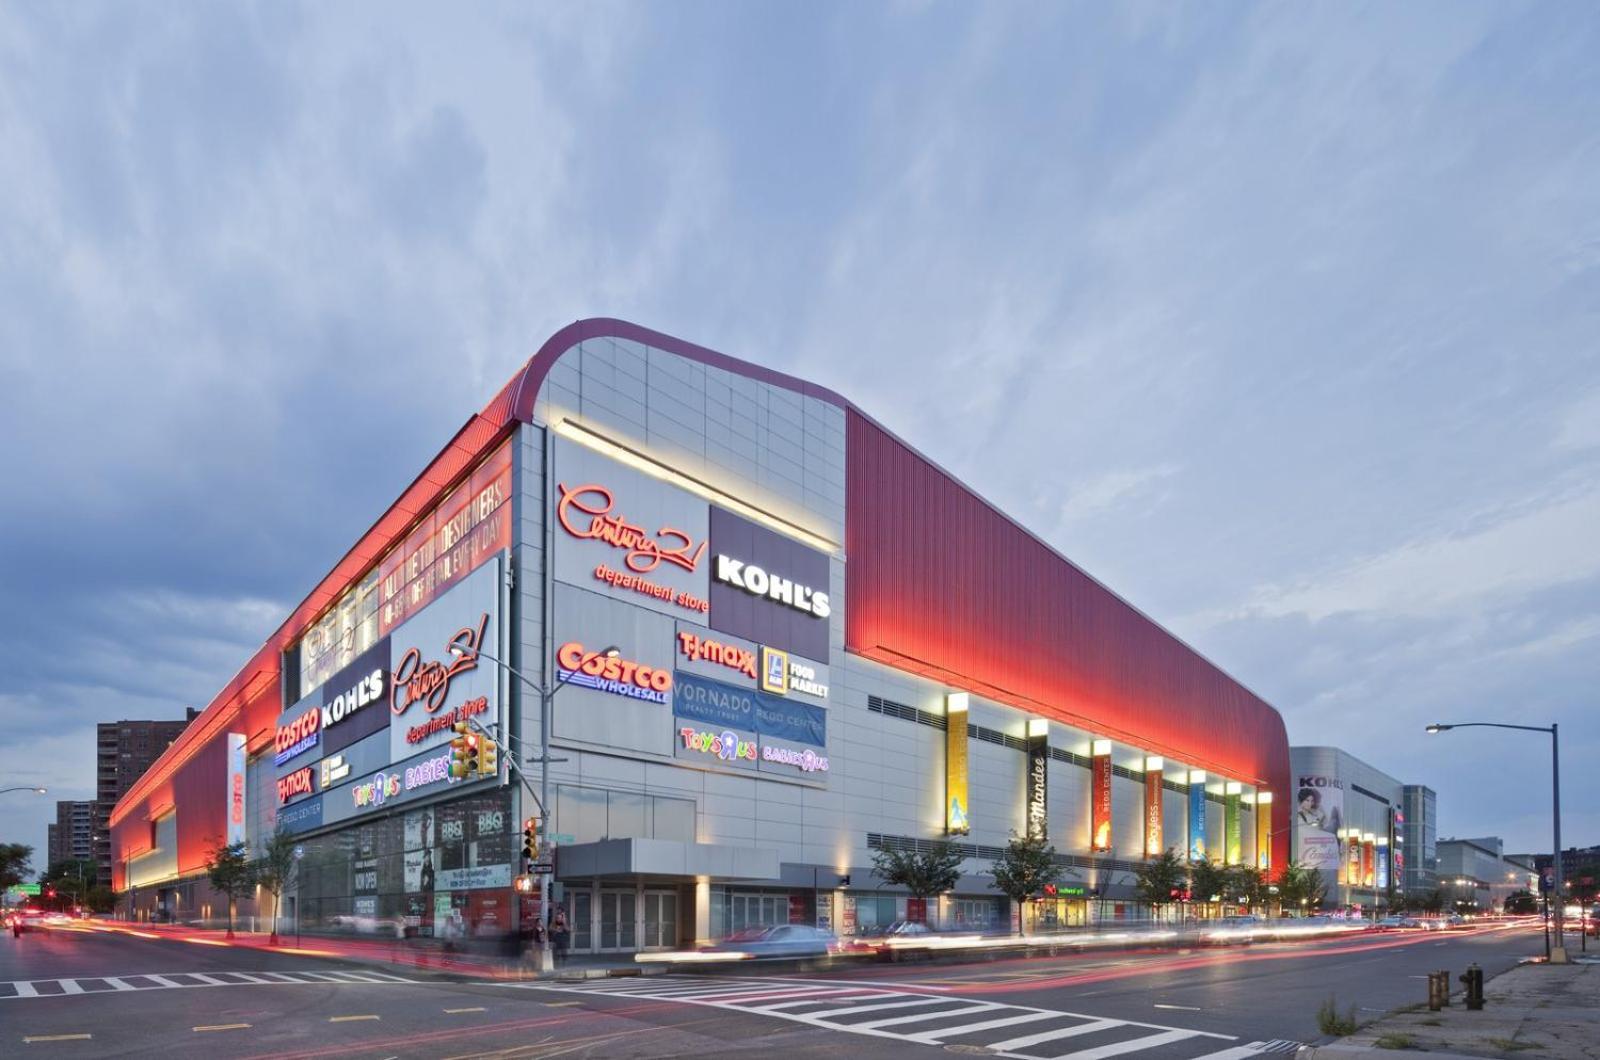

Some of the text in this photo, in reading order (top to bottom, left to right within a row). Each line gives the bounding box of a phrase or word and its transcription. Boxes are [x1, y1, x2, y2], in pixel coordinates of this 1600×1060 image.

[557, 483, 708, 573] Century 21
[594, 563, 710, 613] department store
[717, 554, 832, 618] KOHL'S
[390, 647, 448, 715] Century
[557, 642, 673, 693] COSTCO
[596, 677, 669, 705] WHOLESALE
[790, 677, 829, 698] MARKET
[321, 669, 384, 729] KOHL'S
[405, 696, 488, 744] department store
[672, 682, 750, 713] VORNADO
[275, 707, 319, 753] COSTCO
[1031, 756, 1045, 820] Mandee
